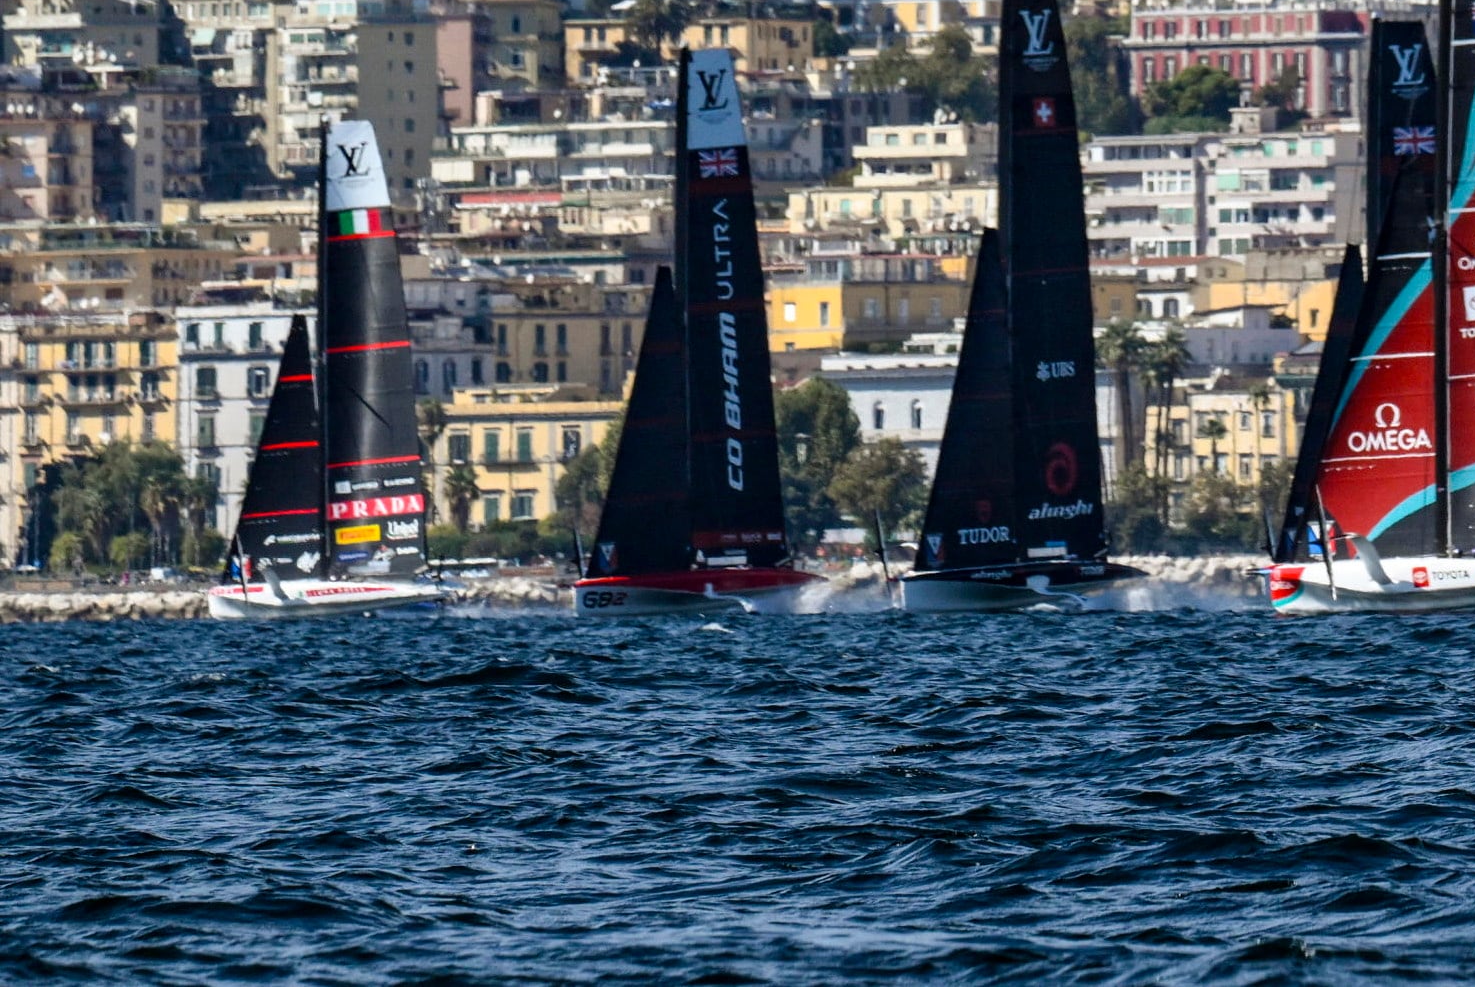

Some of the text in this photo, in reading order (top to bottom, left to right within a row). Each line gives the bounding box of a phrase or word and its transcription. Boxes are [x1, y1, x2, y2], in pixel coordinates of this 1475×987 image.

[712, 198, 735, 301] ULTRA
[1051, 361, 1076, 379] UBS
[1348, 428, 1433, 453] OMEGA
[331, 495, 421, 519] PRADA
[1027, 499, 1094, 520] alinghi
[957, 526, 1011, 545] TUDOR
[1432, 570, 1470, 581] TOYOTA
